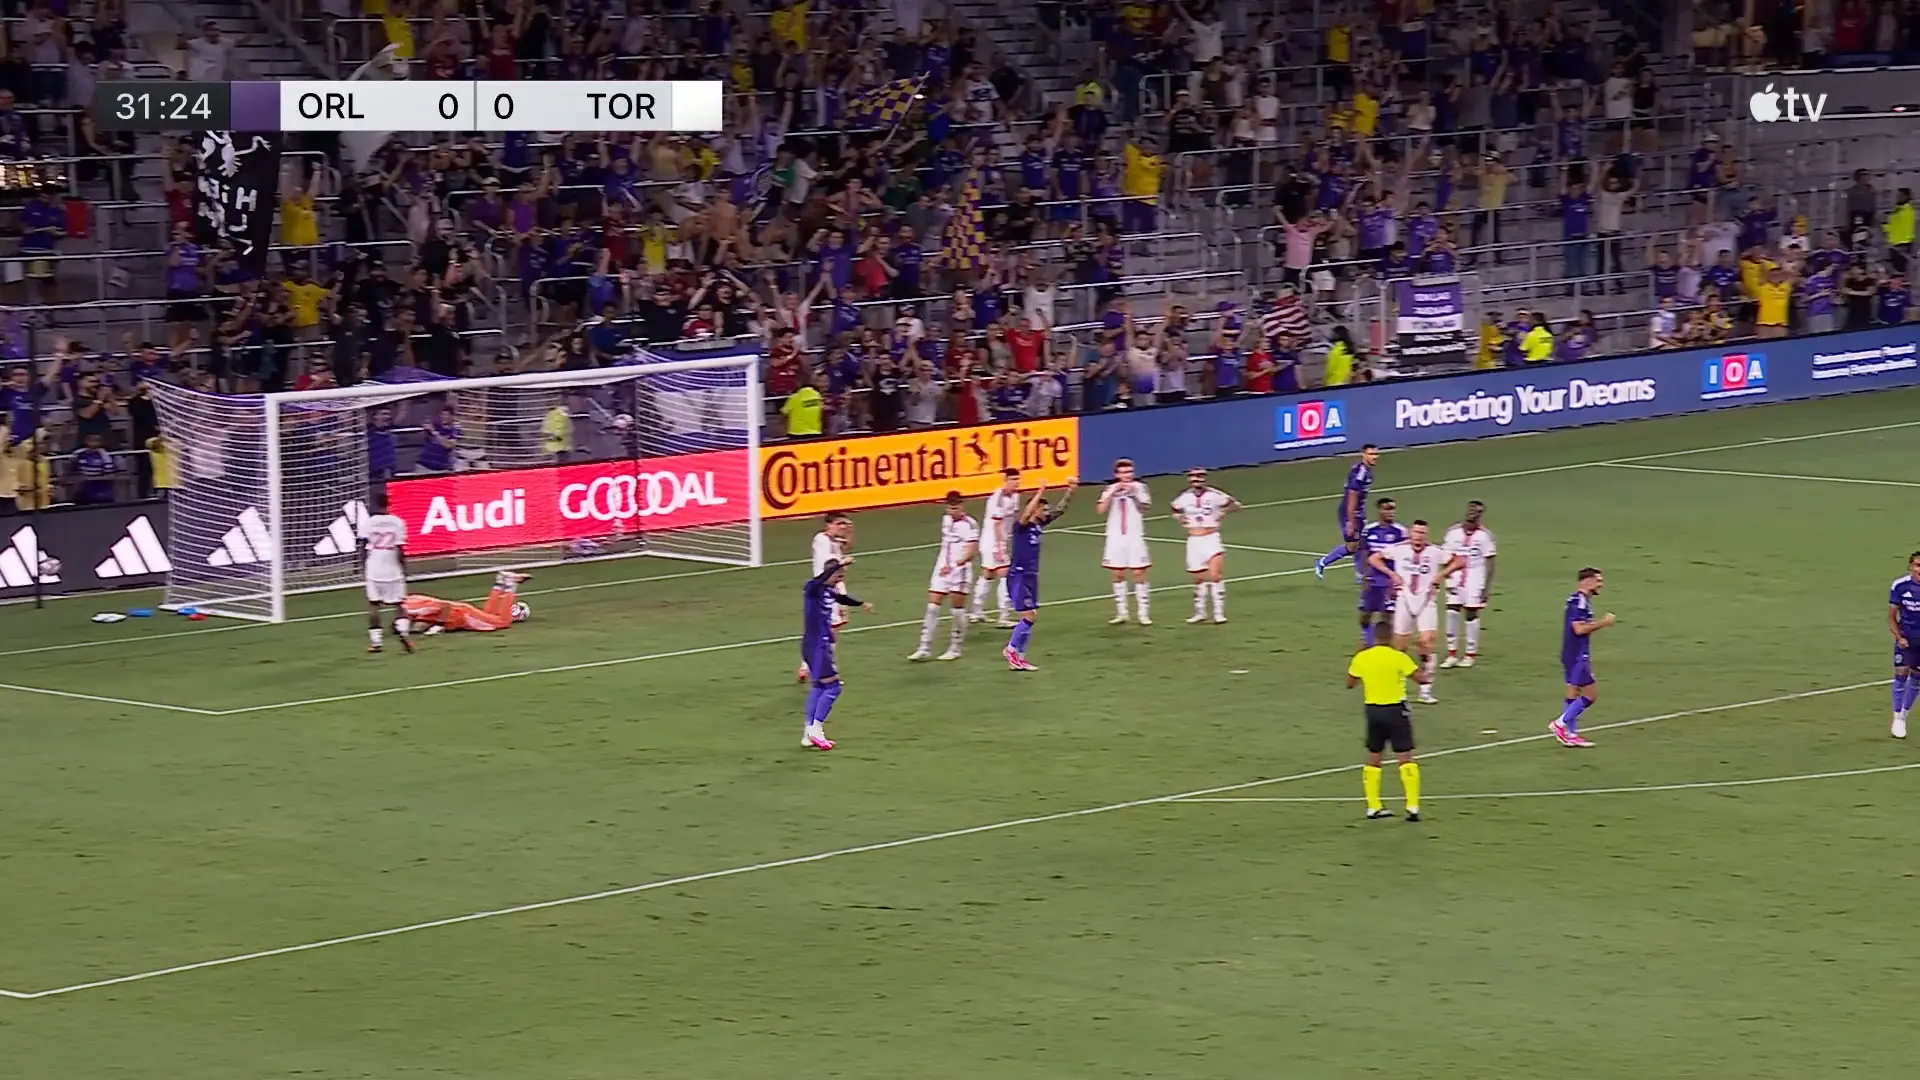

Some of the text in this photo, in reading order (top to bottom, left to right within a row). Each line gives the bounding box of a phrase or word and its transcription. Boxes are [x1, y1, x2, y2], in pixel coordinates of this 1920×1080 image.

[1708, 360, 1764, 385] IOA
[1283, 407, 1342, 433] IOA
[1395, 378, 1656, 428] Protecting Your Dreams
[762, 428, 1069, 509] Continental Tire
[420, 487, 526, 535] Audi
